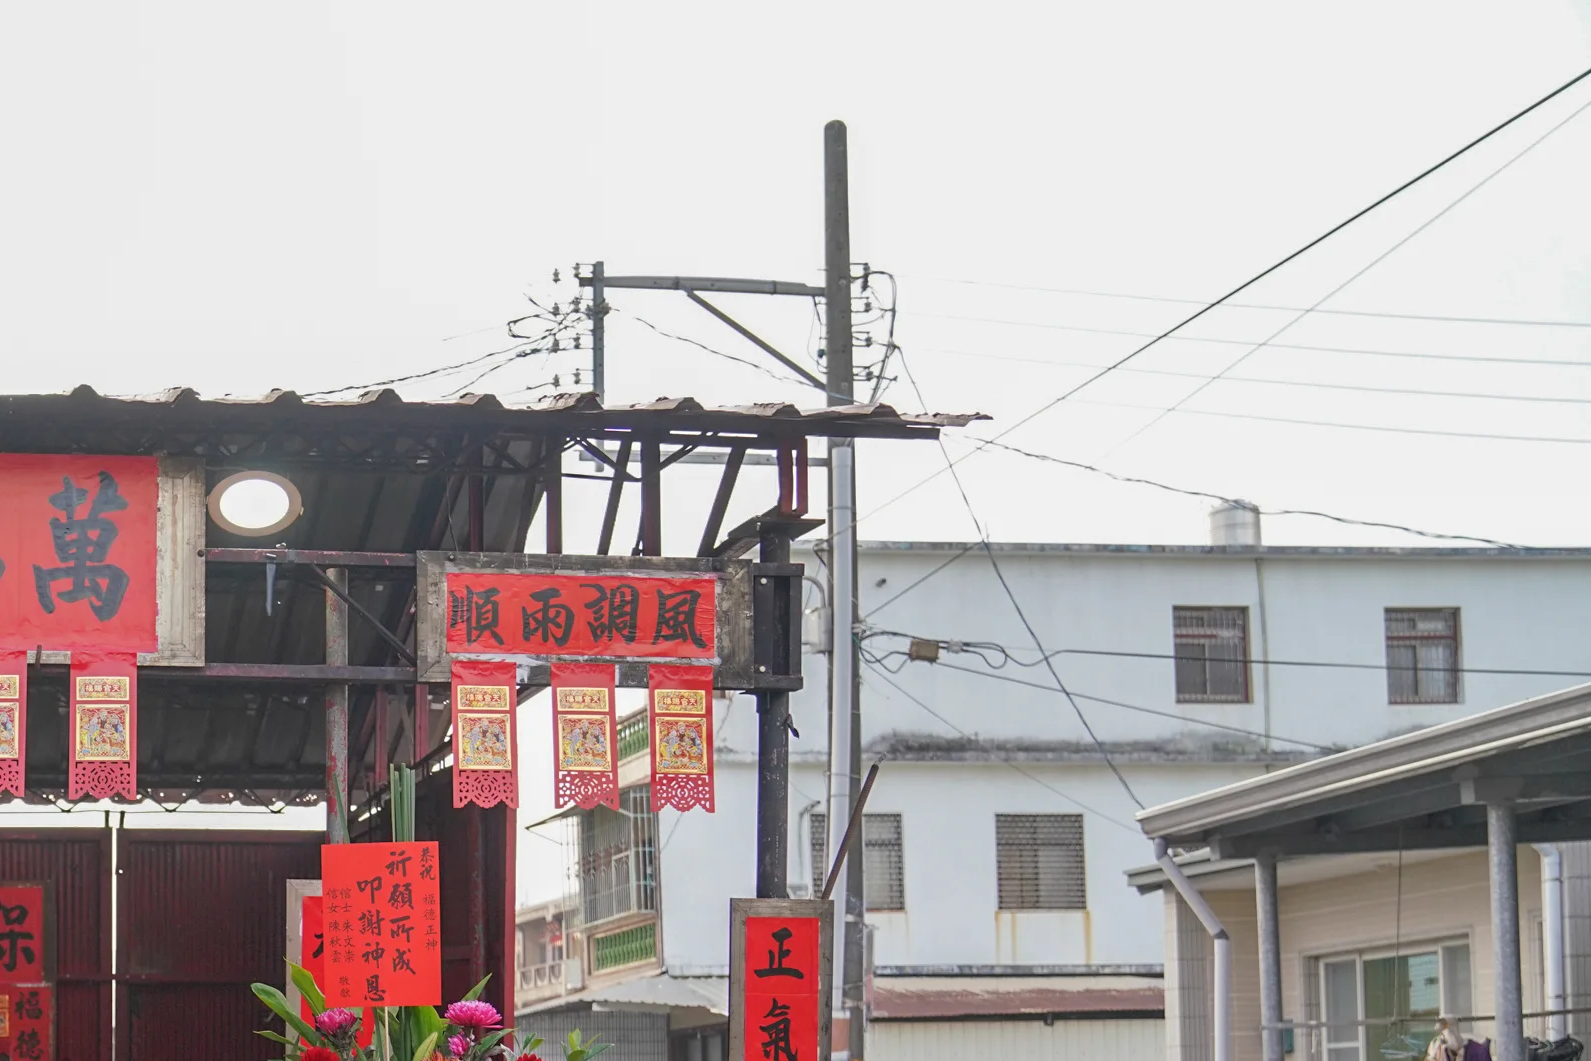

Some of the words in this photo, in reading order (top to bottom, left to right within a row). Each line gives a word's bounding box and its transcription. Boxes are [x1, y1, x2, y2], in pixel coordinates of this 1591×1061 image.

[449, 583, 707, 649] 風調雨順
[356, 876, 386, 1002] 叩謝神恩
[423, 893, 438, 952] 福德正神
